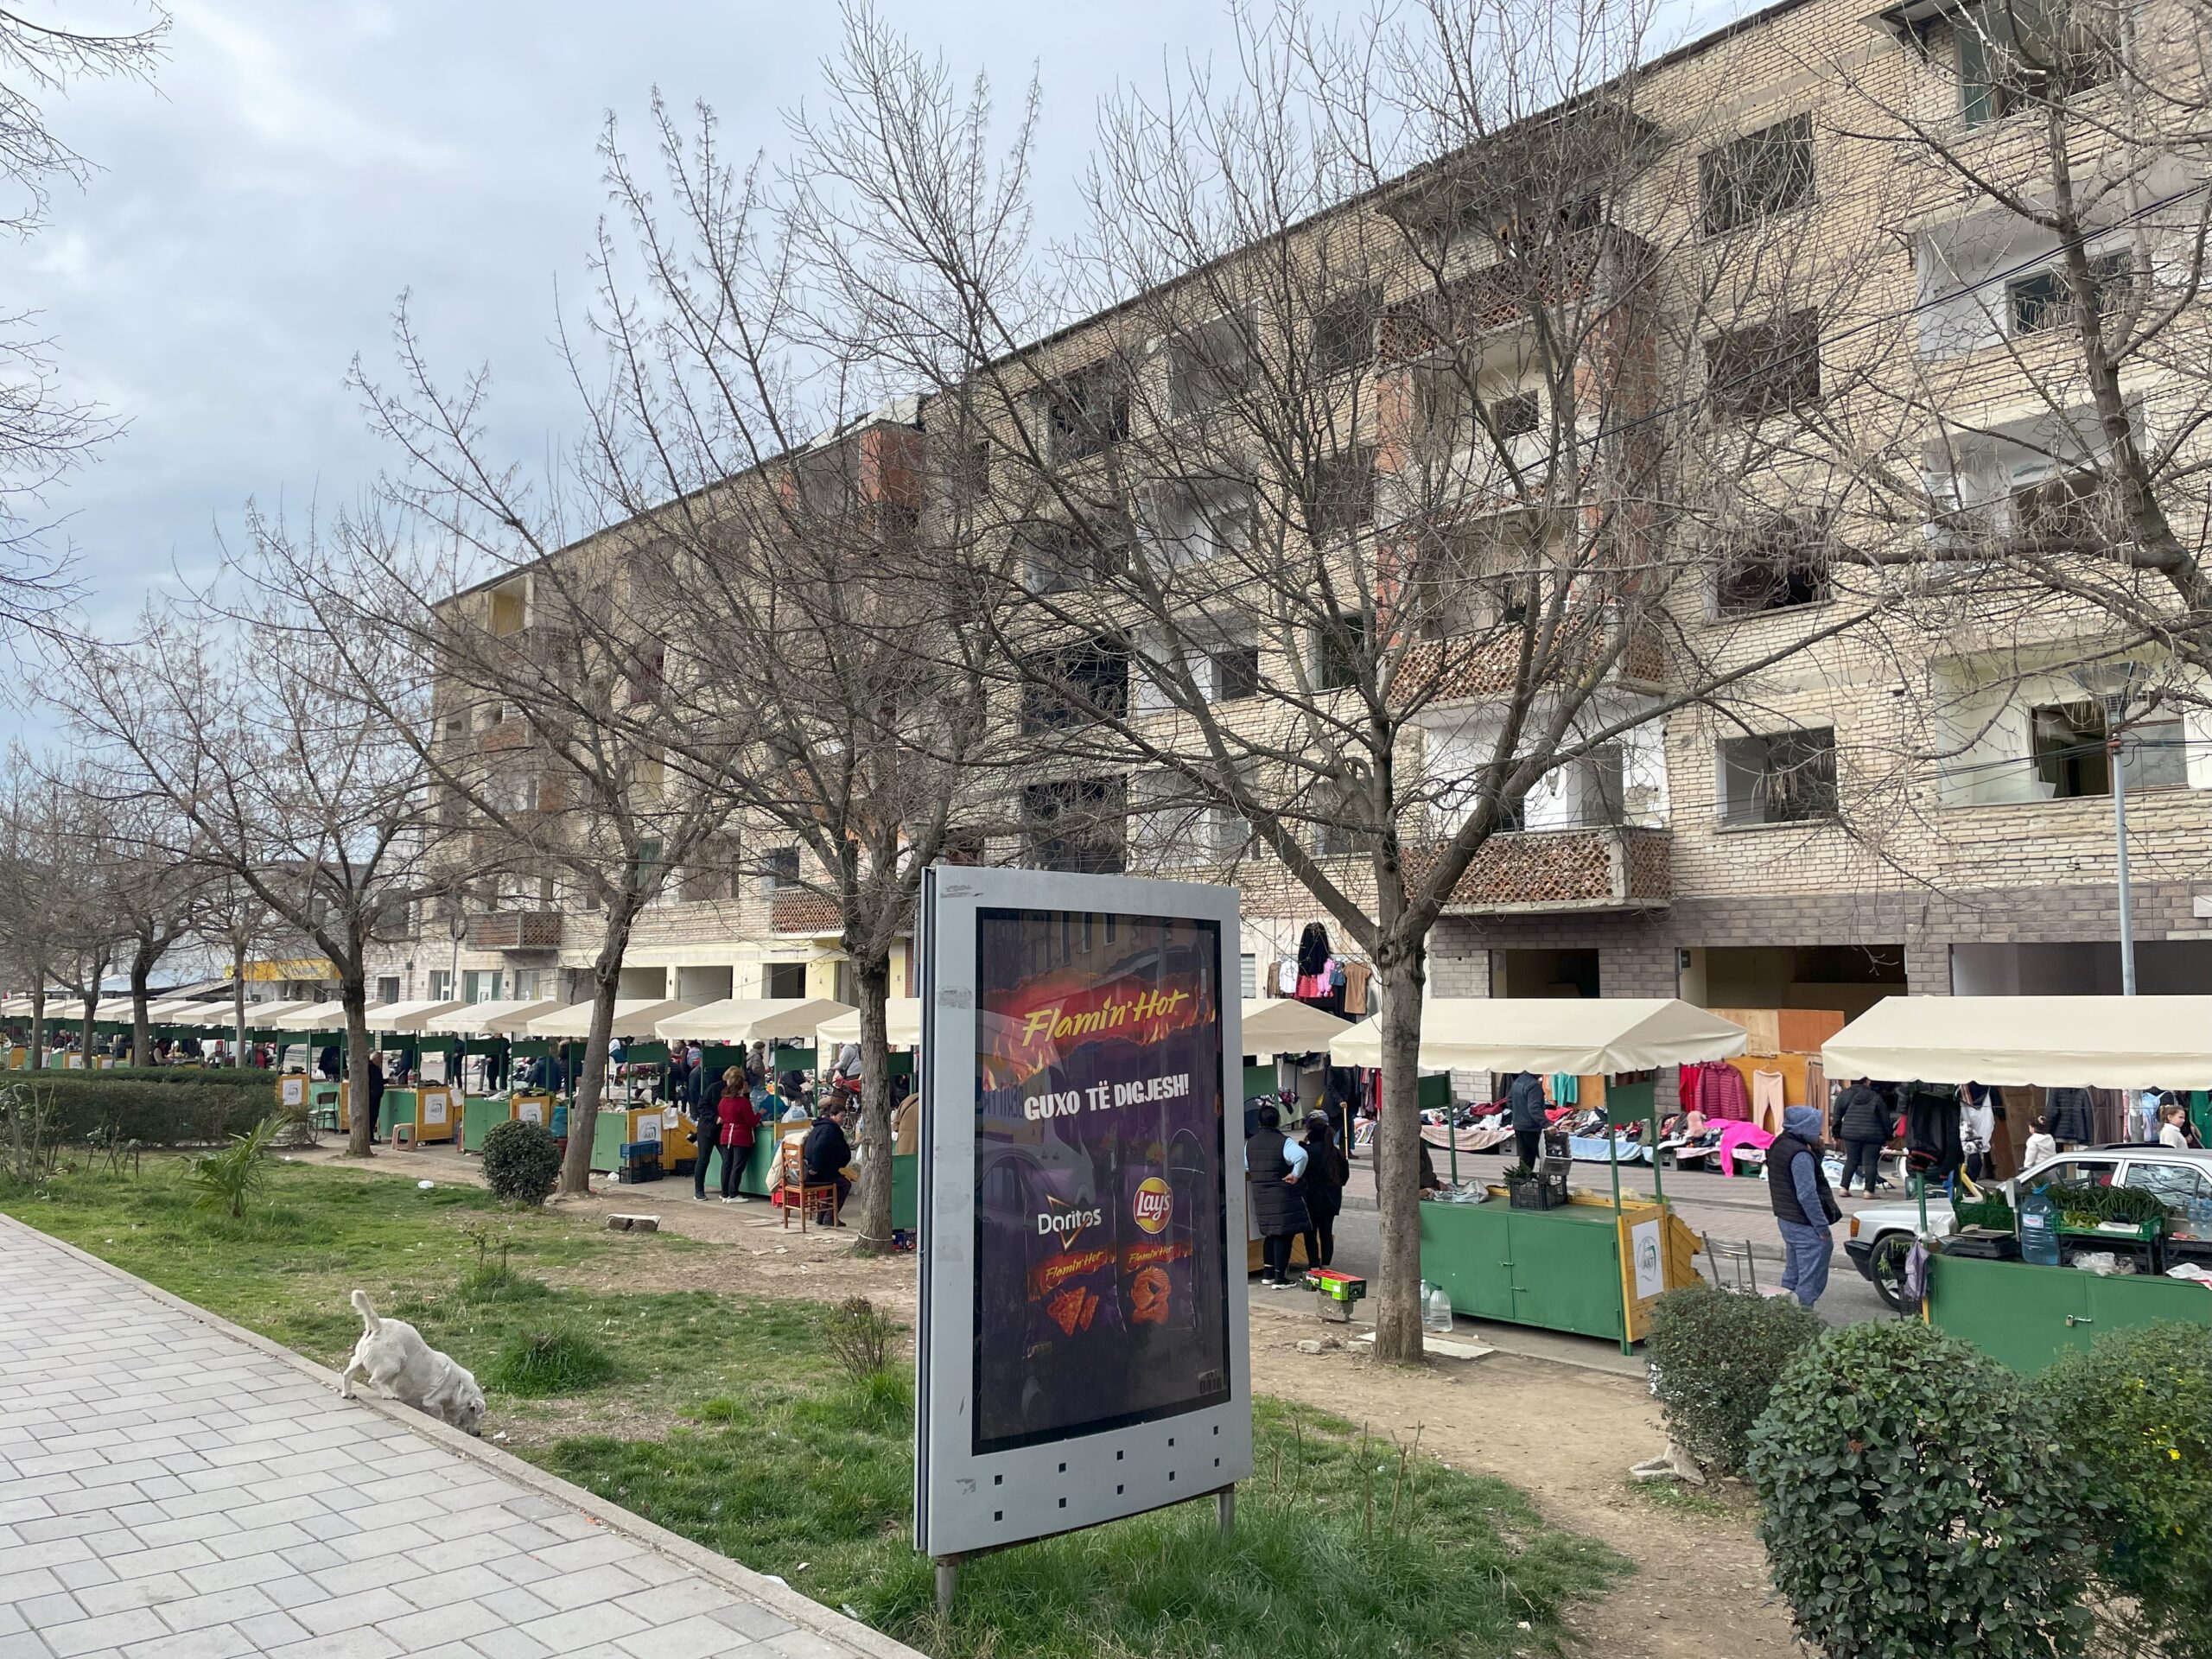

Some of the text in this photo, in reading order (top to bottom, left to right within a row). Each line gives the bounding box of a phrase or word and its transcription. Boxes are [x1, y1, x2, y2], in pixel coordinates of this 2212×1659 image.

[1022, 988, 1190, 1046] Flamin' Hot
[1024, 1073, 1189, 1121] GUXO TË DIGJESH!
[1038, 1208, 1102, 1235] Doritos
[1137, 1191, 1171, 1221] Lay's
[1046, 1250, 1105, 1281] Flamin' Hot
